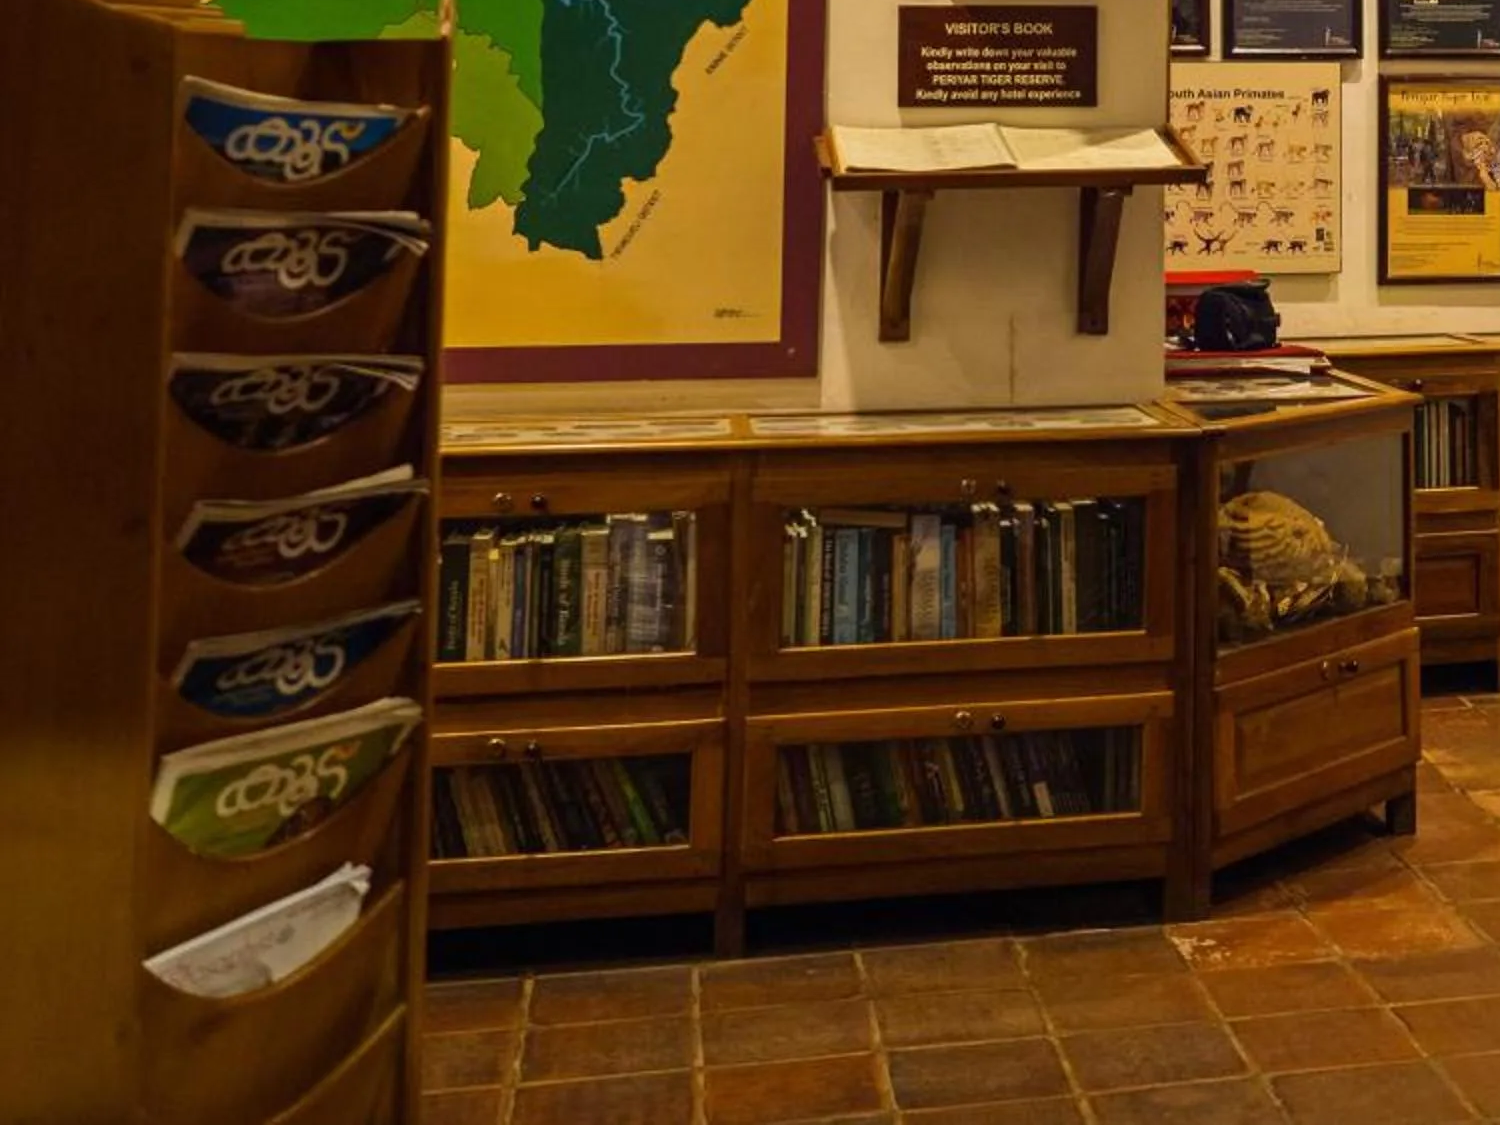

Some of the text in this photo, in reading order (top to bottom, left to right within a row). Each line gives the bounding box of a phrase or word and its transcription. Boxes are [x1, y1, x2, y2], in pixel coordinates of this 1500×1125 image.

[945, 22, 1053, 36] VISITOR'S BOOK
[920, 46, 1078, 60] Kindly write down your valuable
[926, 60, 991, 71] observations
[993, 62, 1007, 71] on
[1008, 62, 1032, 73] your
[1055, 61, 1067, 70] to
[932, 74, 979, 86] PERIYAR
[980, 74, 1012, 86] TIGER
[915, 88, 1082, 102] Kindly avoid any hotel experience
[1167, 88, 1286, 100] outh Asian Primates
